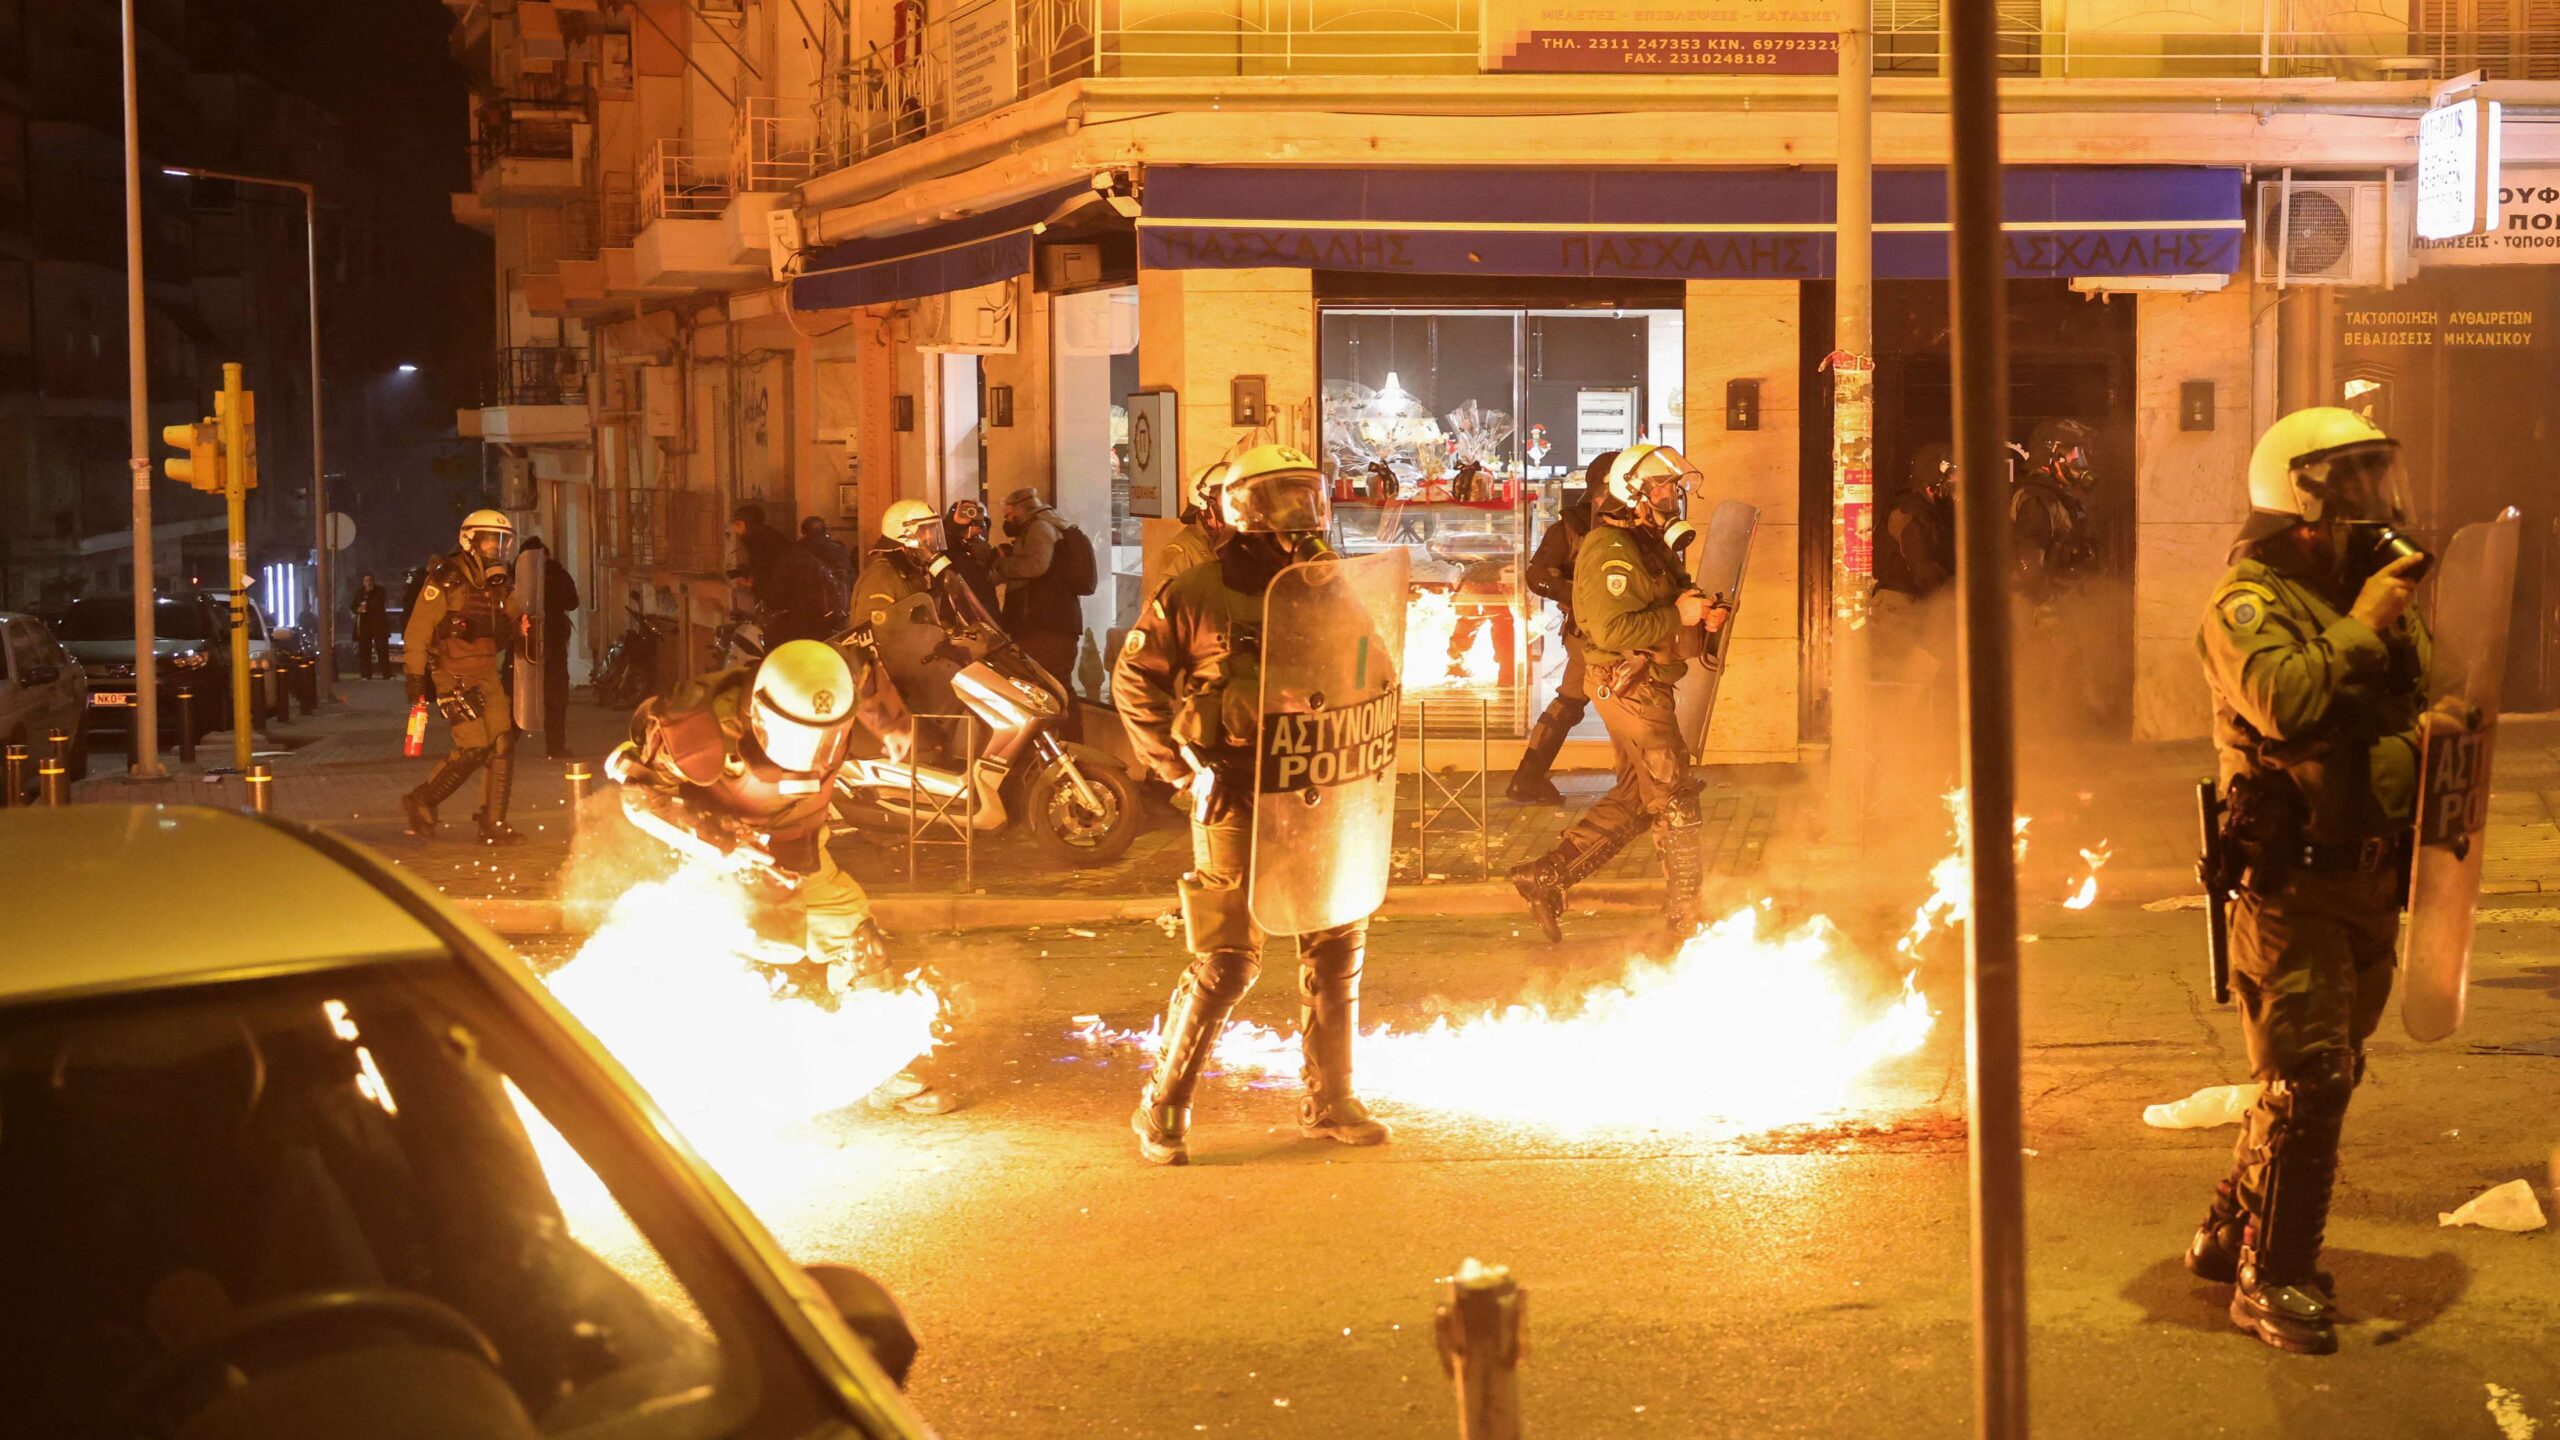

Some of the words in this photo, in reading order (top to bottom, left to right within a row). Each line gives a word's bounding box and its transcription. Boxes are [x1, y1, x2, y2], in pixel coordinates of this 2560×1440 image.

[1541, 38, 1581, 49] ΤΗΛ.
[1588, 38, 1630, 49] 2311
[1637, 38, 1701, 50] 247353
[1708, 39, 1745, 50] ΚΙΝ.
[1624, 53, 1662, 64] FAX.
[1669, 53, 1777, 65] 2310248182
[1165, 230, 1413, 267] ΠΑΣΧΑΛΗΣ
[1561, 236, 1809, 273] ΠΑΣΧΑΛΗΣ
[2000, 233, 2212, 271] ΑΣΧΑΛΗΣ
[2345, 312, 2438, 325] ΤΑΚΤΟΠΟΙΗΣΗ
[2449, 311, 2532, 325] ΑΥΘΑΙΡΕΤΩΝ
[2344, 332, 2432, 346] ΒΕΒΑΙΩΣΕΙΣ
[2444, 332, 2532, 345] ΜΗΧΑΝΙΚΟΥ
[1270, 689, 1398, 756] ΑΣΤΥΝΟΜΙΑ
[1278, 730, 1394, 789] POLICE
